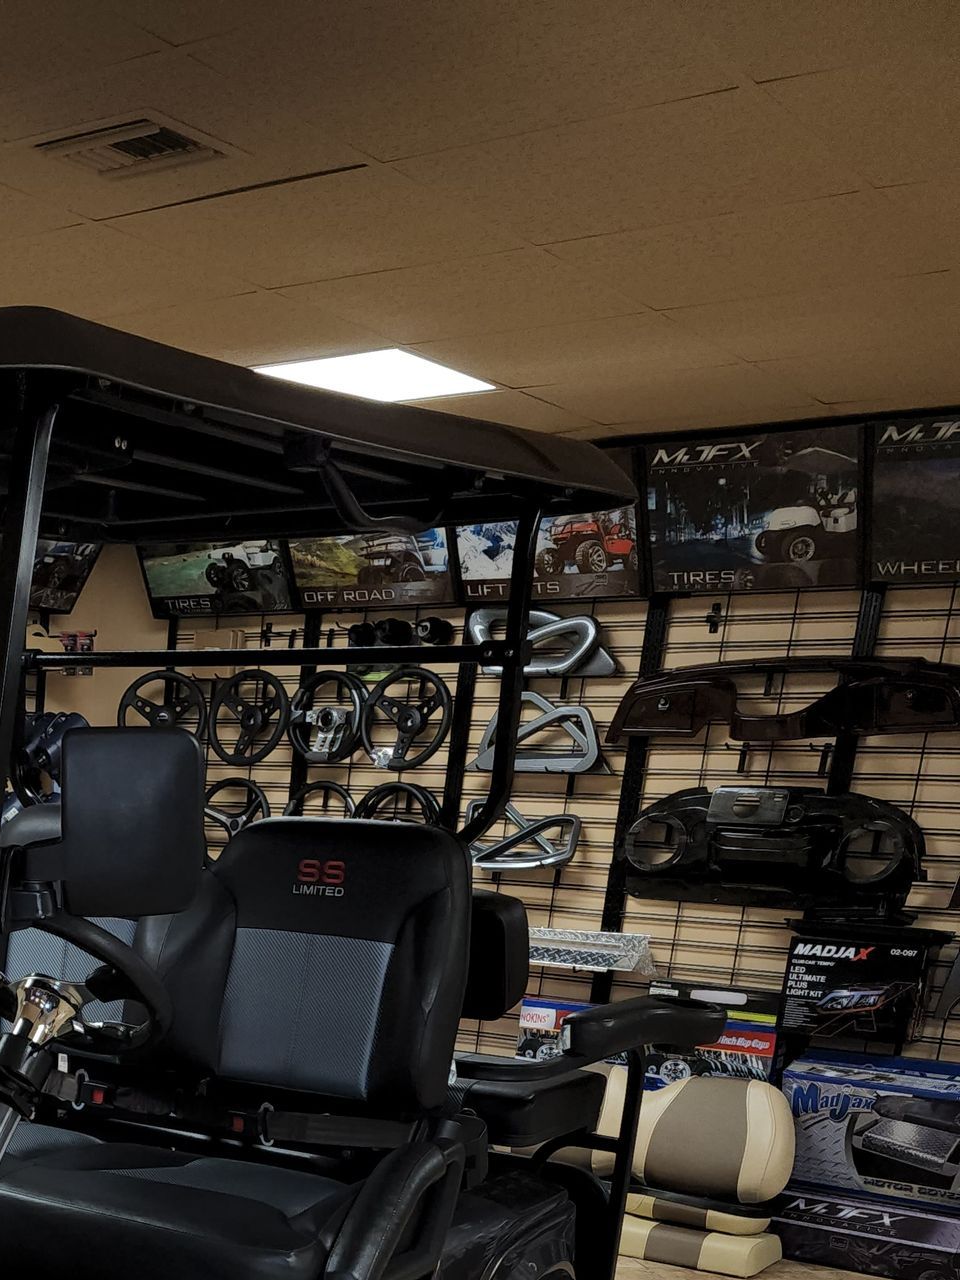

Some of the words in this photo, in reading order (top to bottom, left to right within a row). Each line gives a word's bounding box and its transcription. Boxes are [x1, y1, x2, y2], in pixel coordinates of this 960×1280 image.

[650, 461, 759, 475] INNOVATIVE
[668, 570, 735, 585] TIRES
[304, 591, 337, 603] OFF
[344, 589, 395, 601] ROAD
[467, 583, 507, 596] LIFT
[165, 598, 211, 610] TIRES
[297, 859, 346, 884] SS
[292, 884, 345, 897] LIMITED
[793, 942, 876, 961] MADJAX
[890, 948, 918, 957] 02-097
[790, 965, 806, 973] LED
[787, 980, 808, 989] PLUS
[788, 973, 827, 983] ULTIMATE
[786, 988, 809, 996] LIGHT
[809, 990, 824, 998] KIT
[863, 1178, 913, 1193] MOTOR
[781, 1211, 898, 1236] INNOVATIVE
